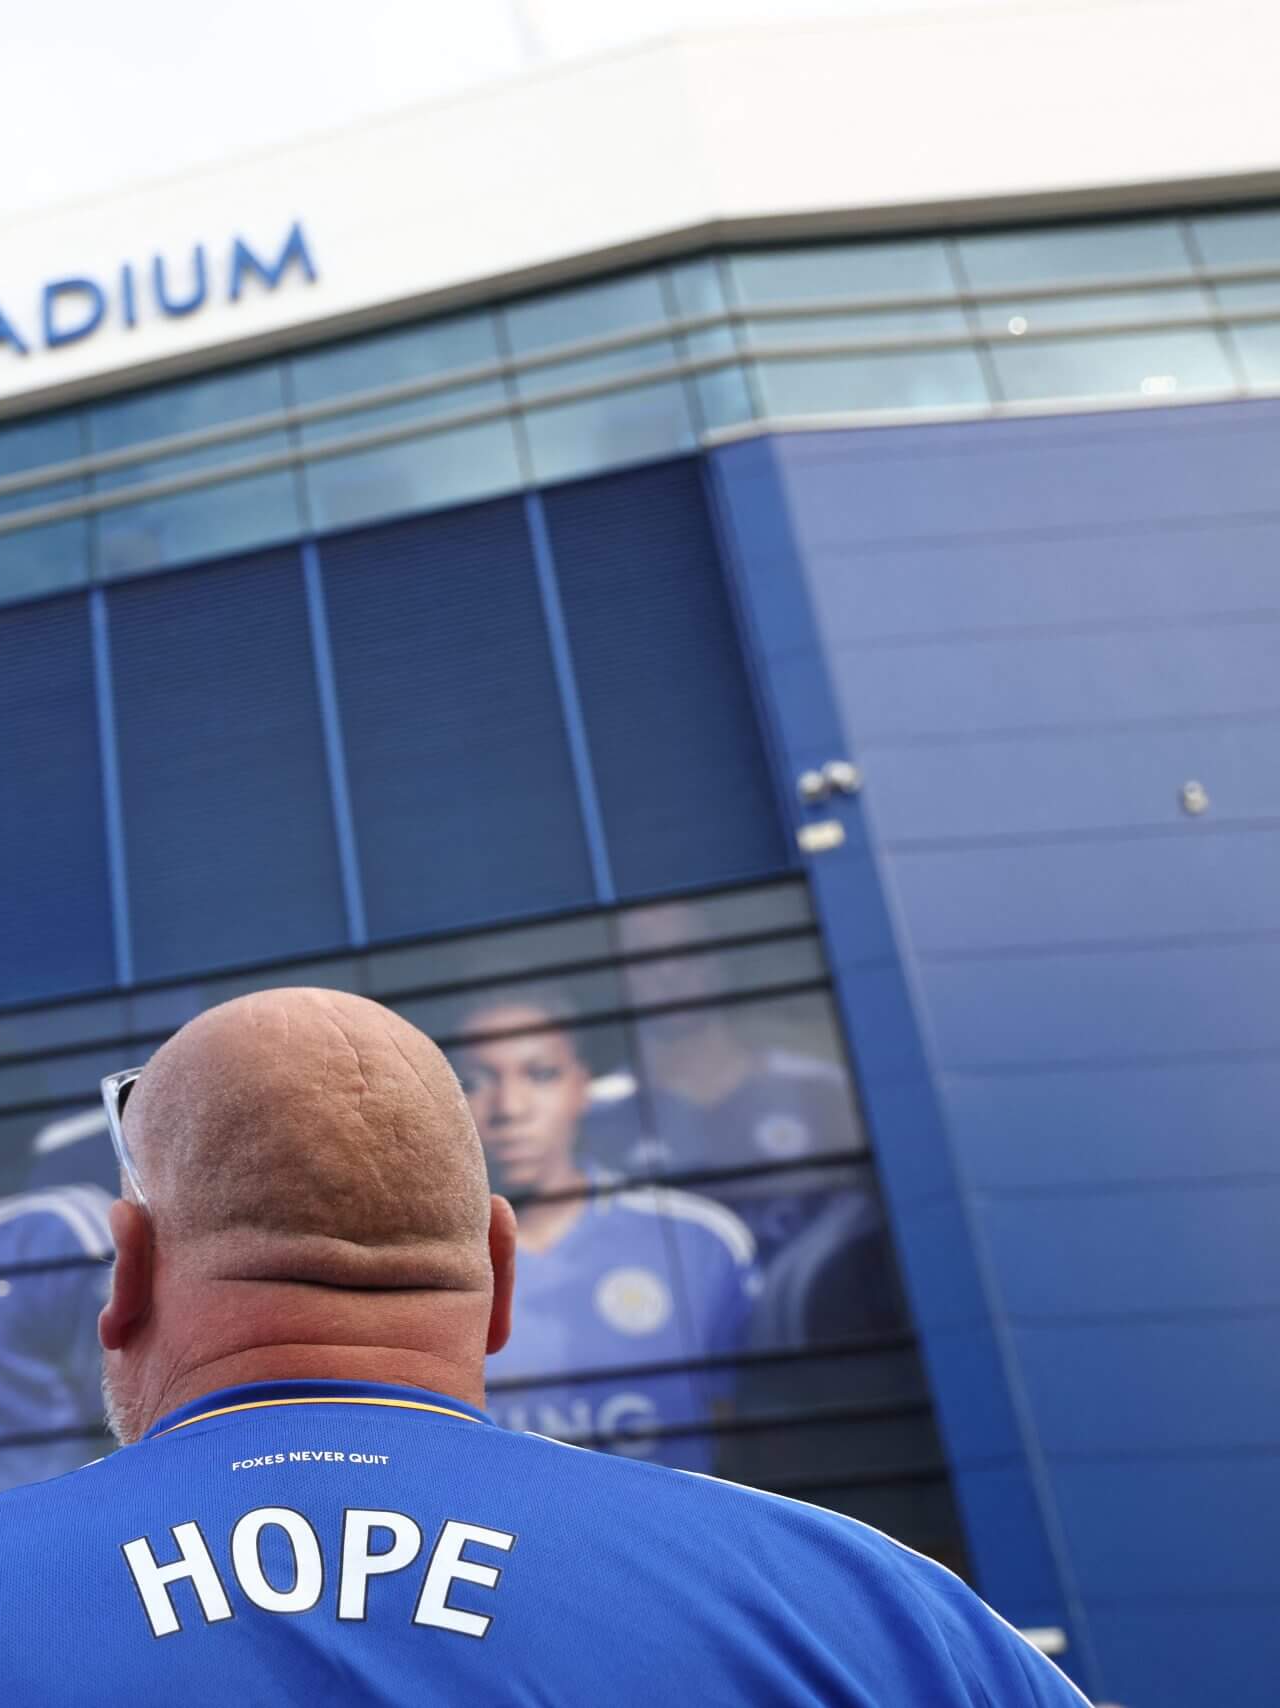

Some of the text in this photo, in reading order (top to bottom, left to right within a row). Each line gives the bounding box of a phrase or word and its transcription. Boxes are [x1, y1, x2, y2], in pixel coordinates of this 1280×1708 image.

[231, 1451, 389, 1471] FOXES NEVER QUIT
[120, 1505, 518, 1639] HOPE
